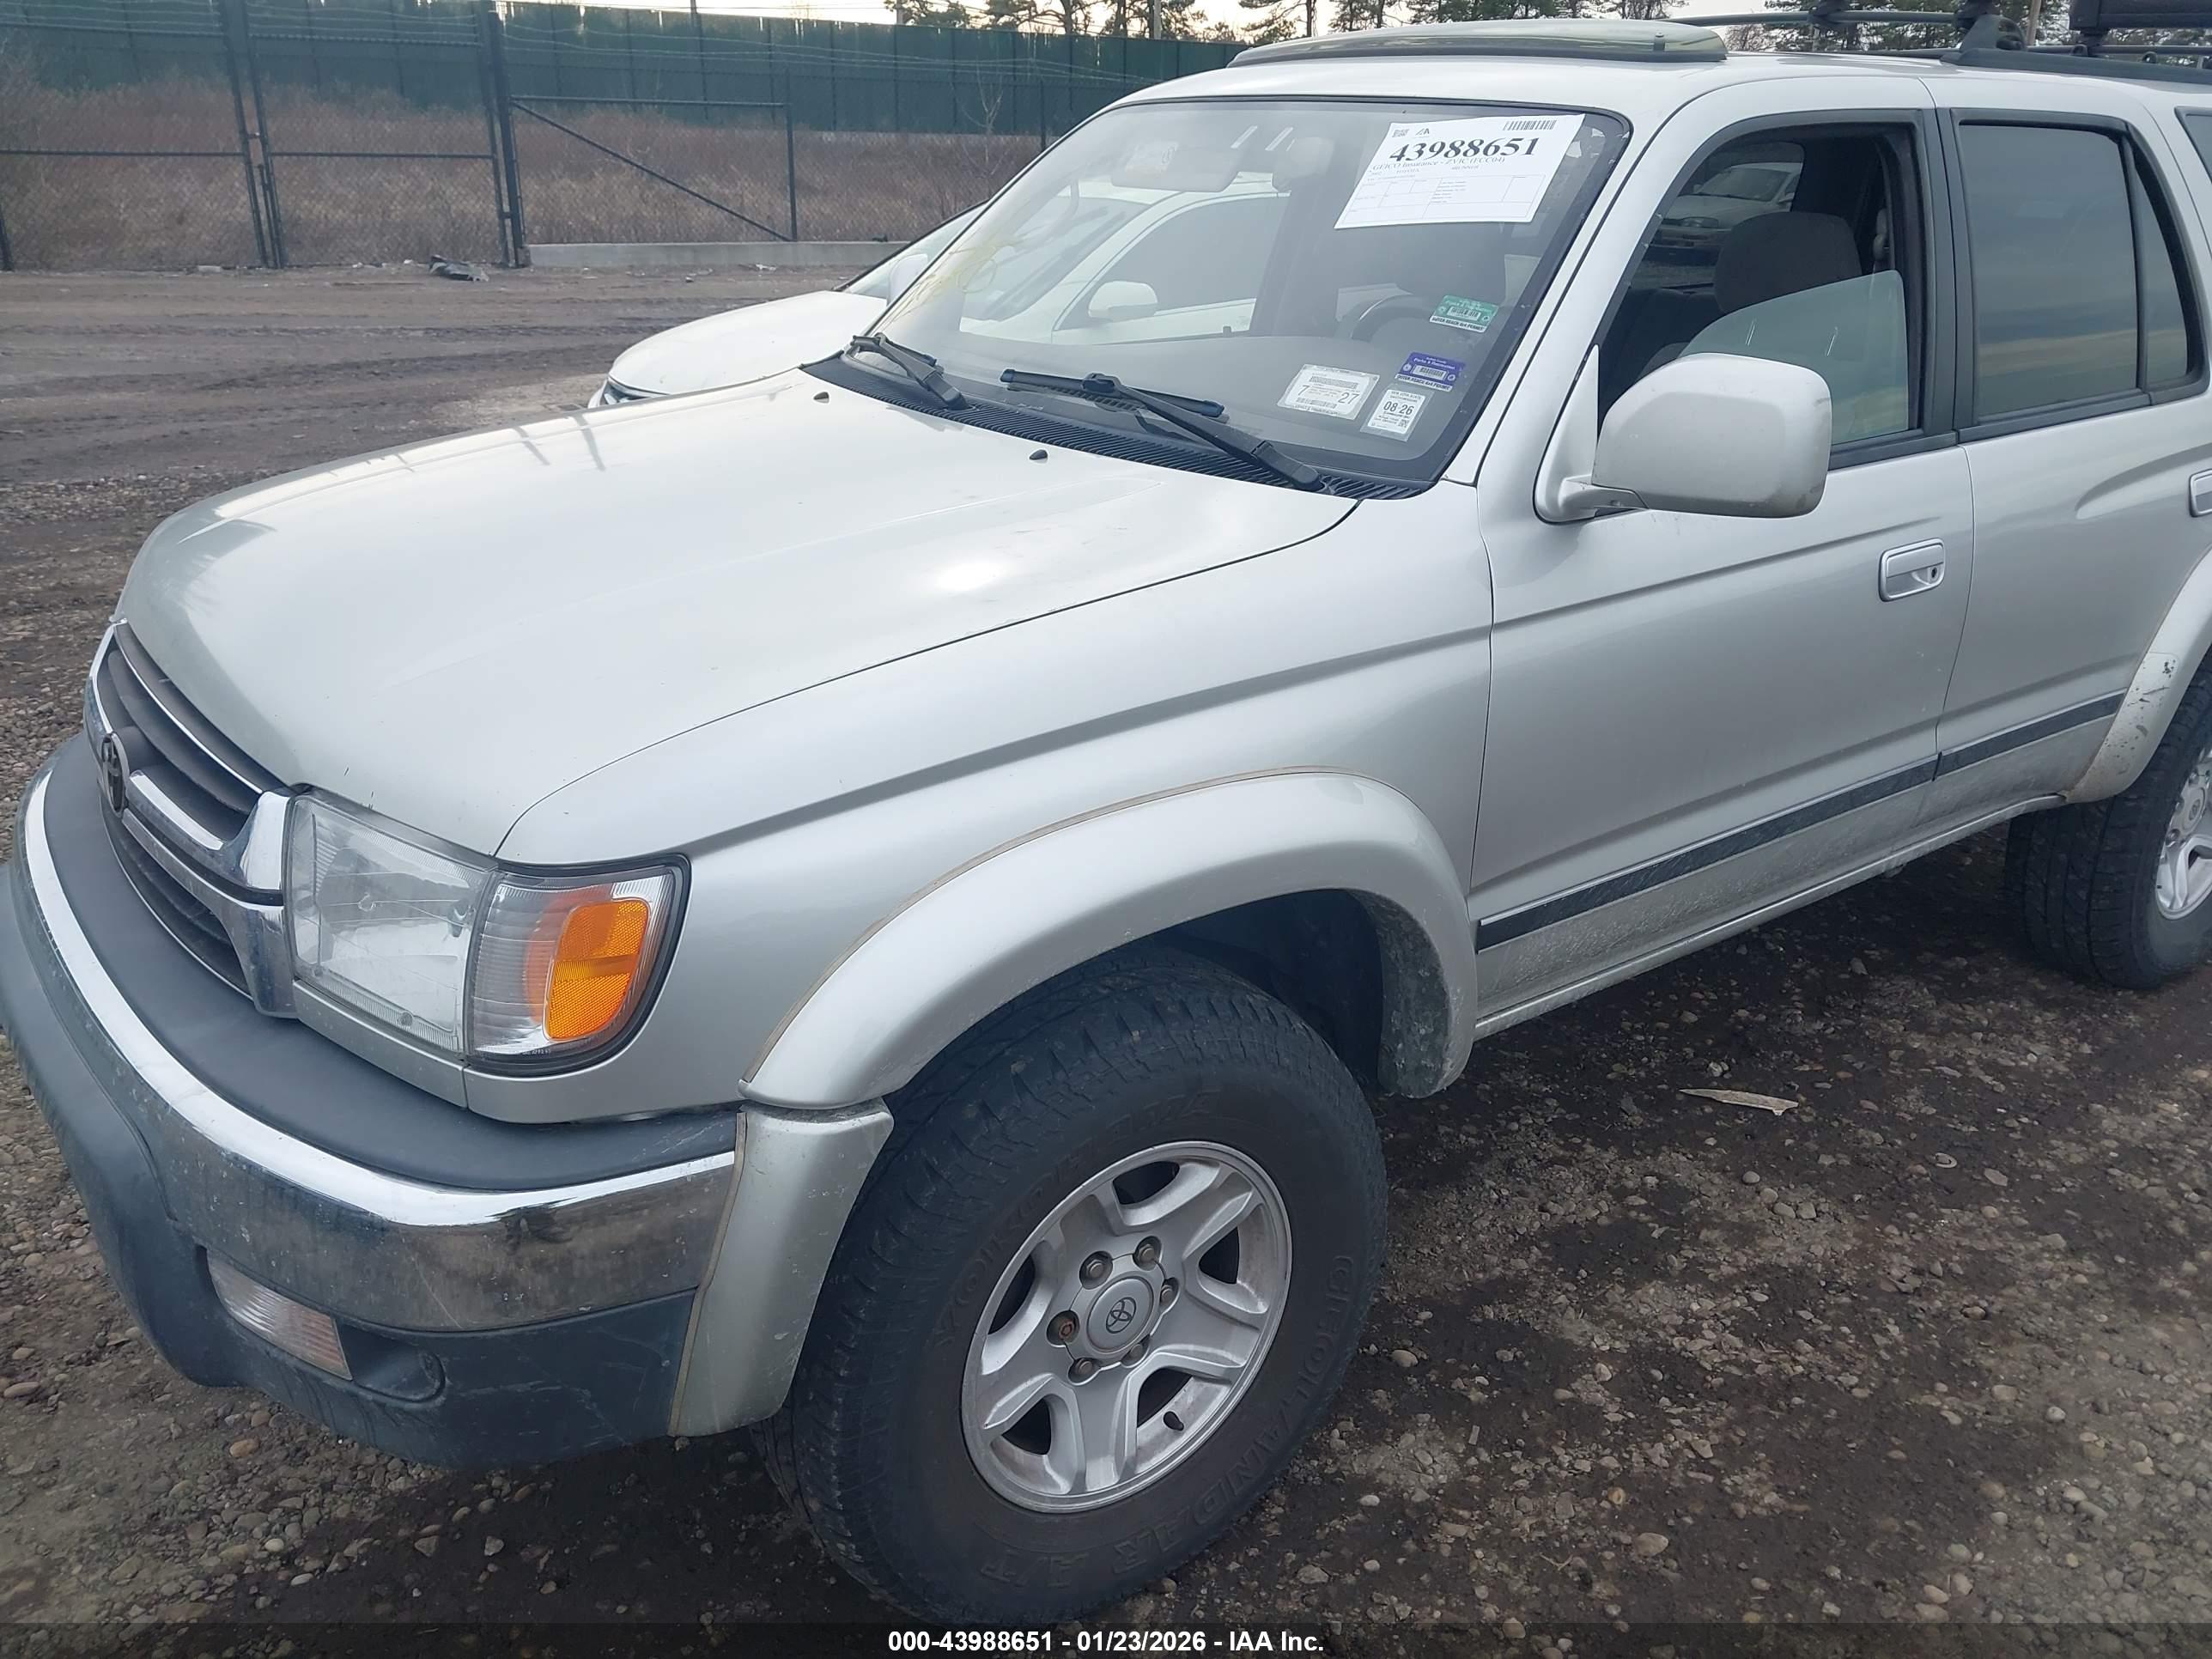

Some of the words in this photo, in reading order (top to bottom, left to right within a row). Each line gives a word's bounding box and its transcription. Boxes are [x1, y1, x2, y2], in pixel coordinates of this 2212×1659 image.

[1389, 137, 1540, 162] 43988651
[1297, 385, 1310, 396] 7
[1338, 392, 1360, 404] 27
[1383, 401, 1398, 412] 08
[1399, 404, 1414, 415] 26
